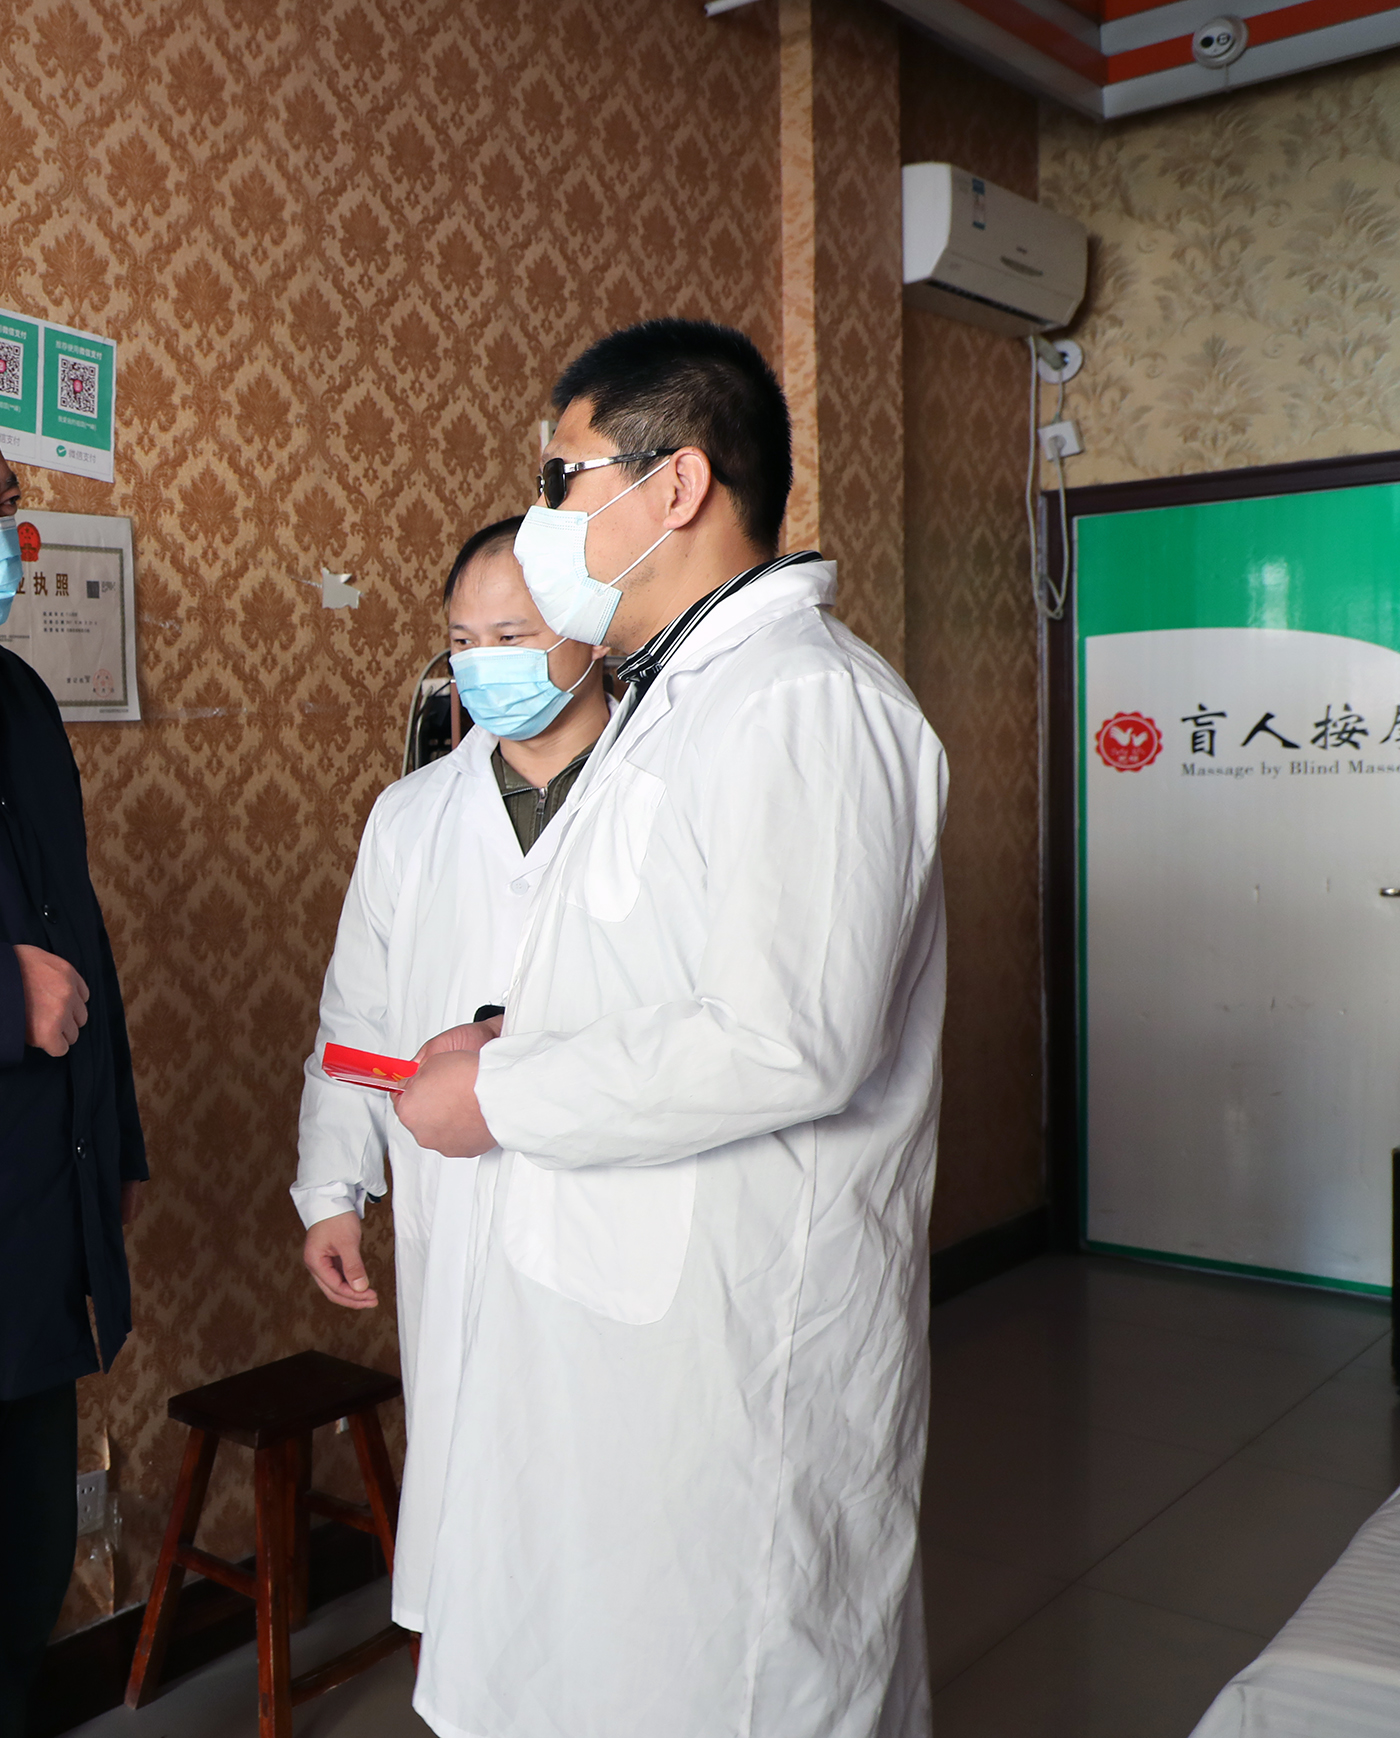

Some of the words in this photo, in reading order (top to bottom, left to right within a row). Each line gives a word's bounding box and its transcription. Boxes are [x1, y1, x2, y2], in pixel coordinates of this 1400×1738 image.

[68, 448, 96, 464] 微信支付
[1180, 762, 1253, 780] Massage
[1261, 761, 1282, 778] by
[1290, 760, 1339, 775] Blind
